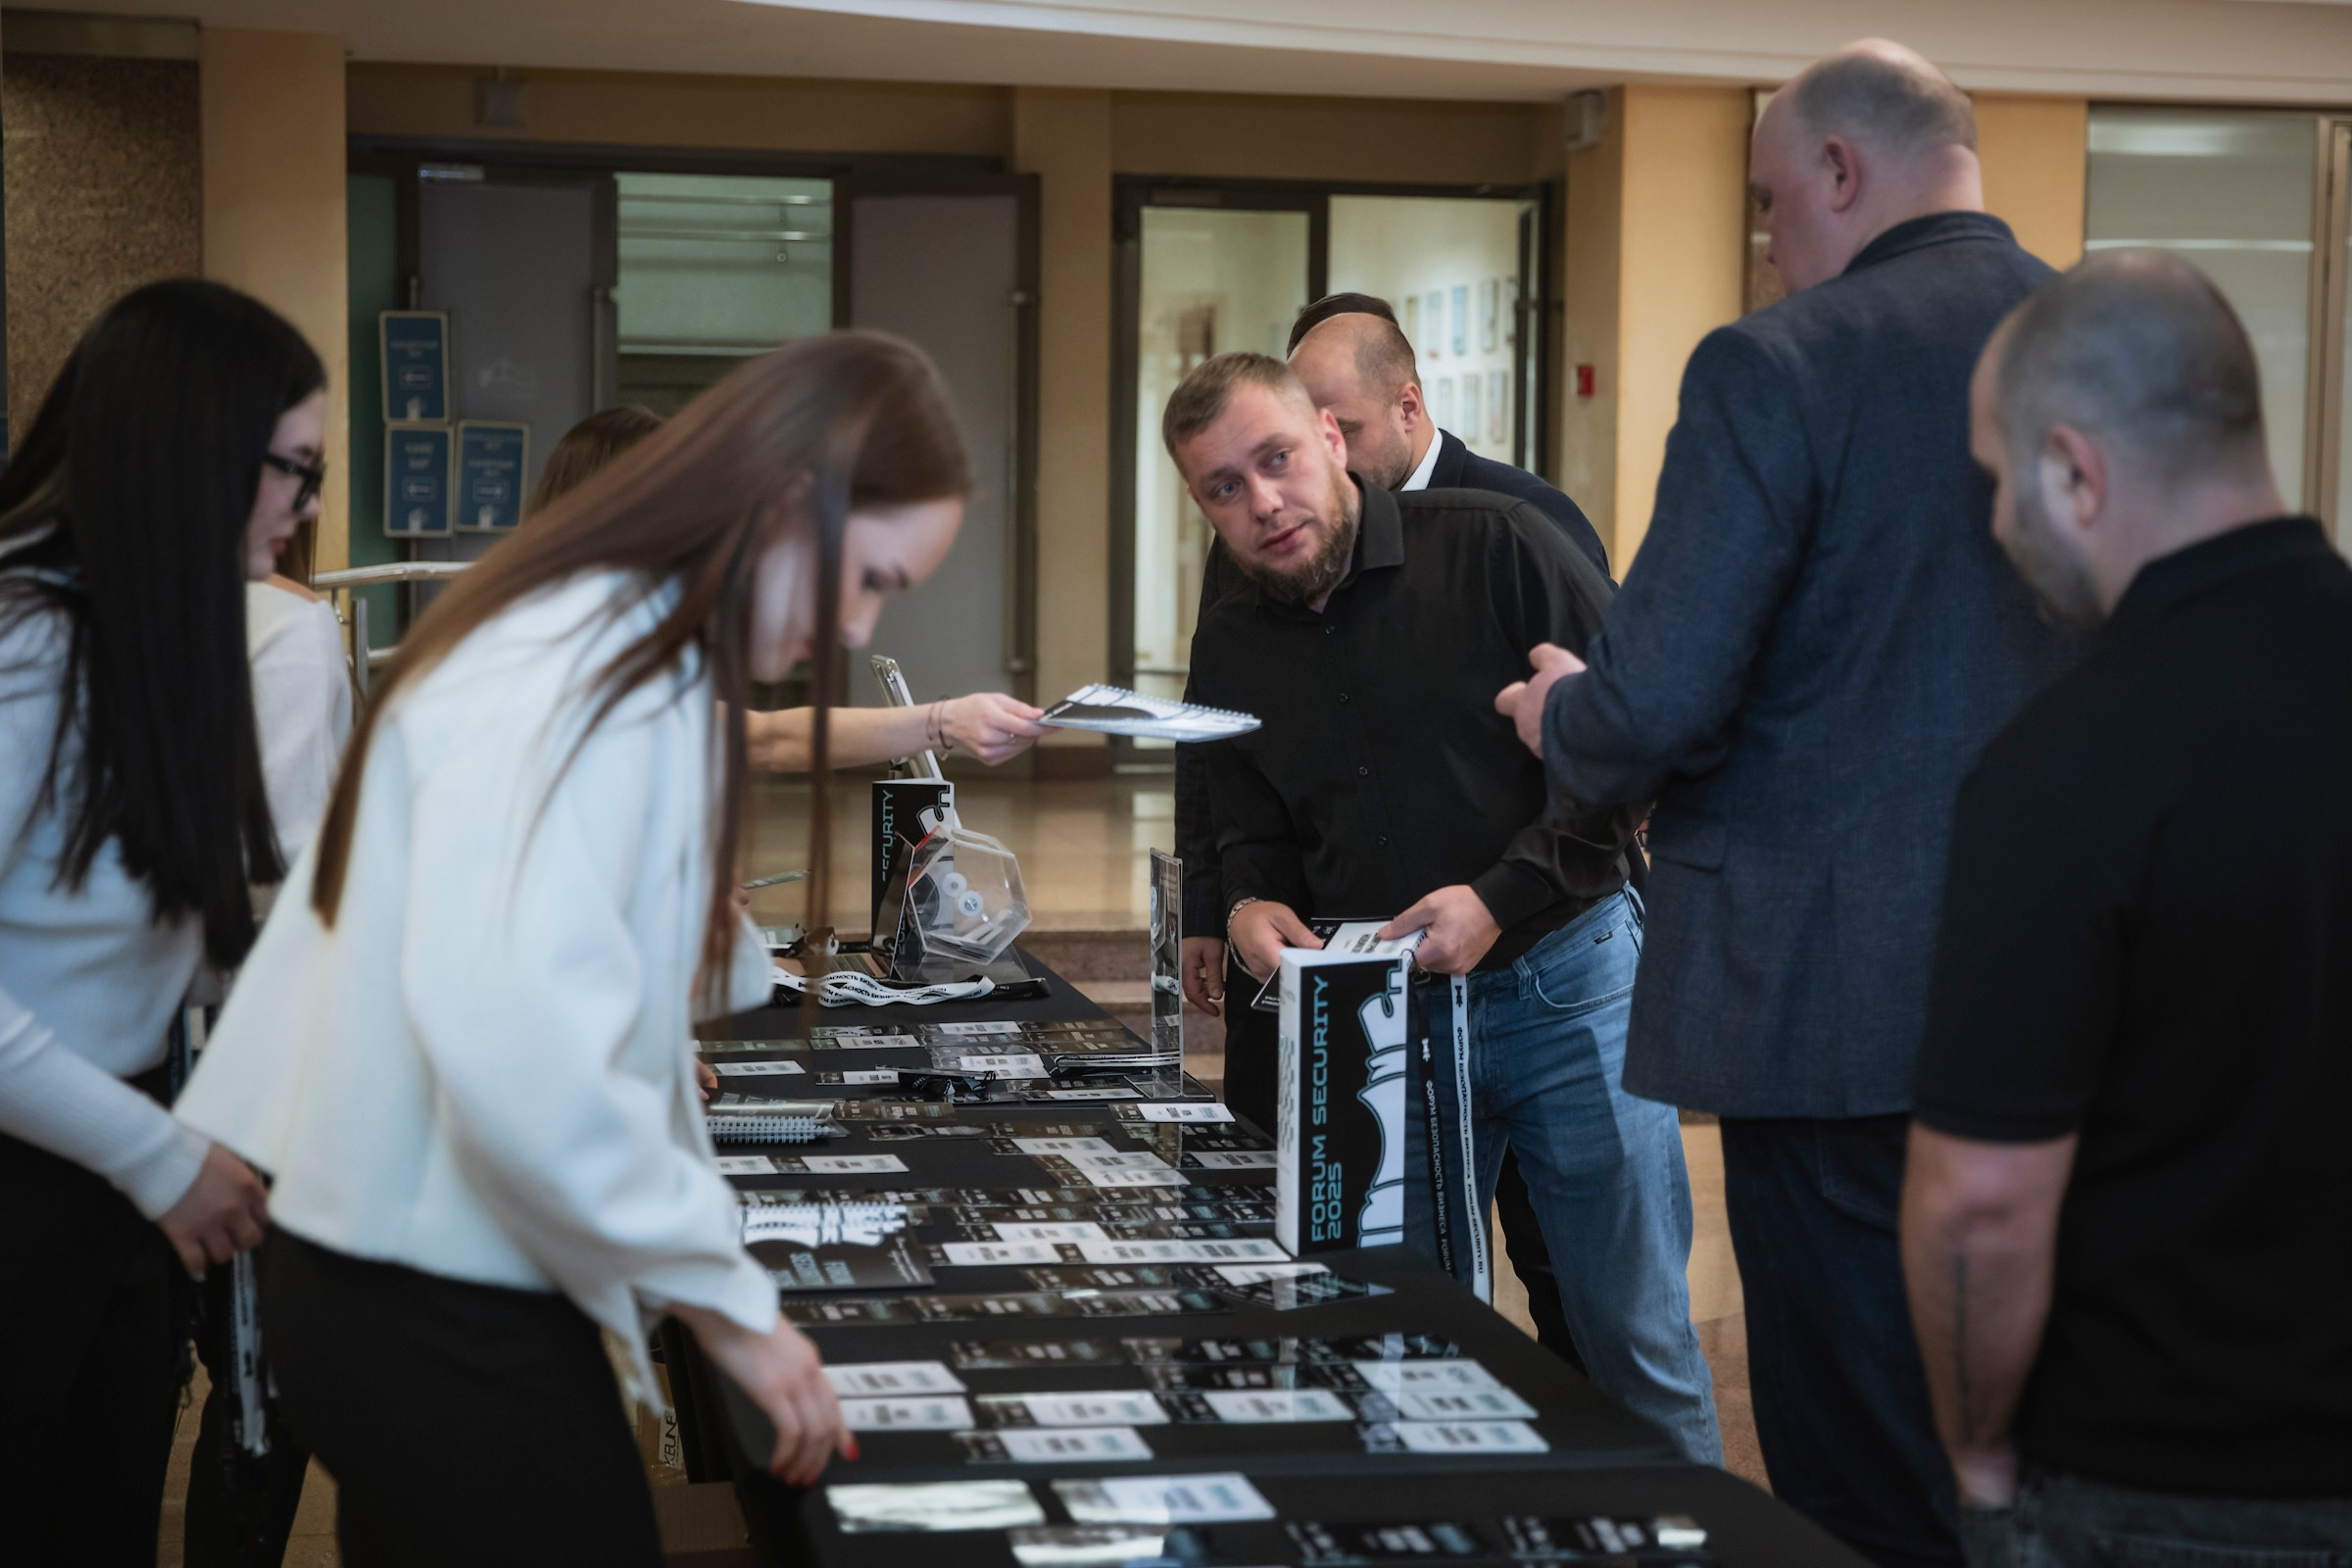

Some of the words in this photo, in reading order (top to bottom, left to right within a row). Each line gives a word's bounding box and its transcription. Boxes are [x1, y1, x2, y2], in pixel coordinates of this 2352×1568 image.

[1312, 975, 1329, 1126] SECURITY
[1426, 1080, 1437, 1115] ФОРУМ
[1459, 1062, 1469, 1135] БЕЗОПАСНОСТЬ
[1311, 1135, 1326, 1242] FORUM
[1430, 1117, 1444, 1190] БЕЗОПАСНОСТЬ
[1327, 1161, 1343, 1240] 2025
[1437, 1191, 1447, 1235] БИЗНЕСА
